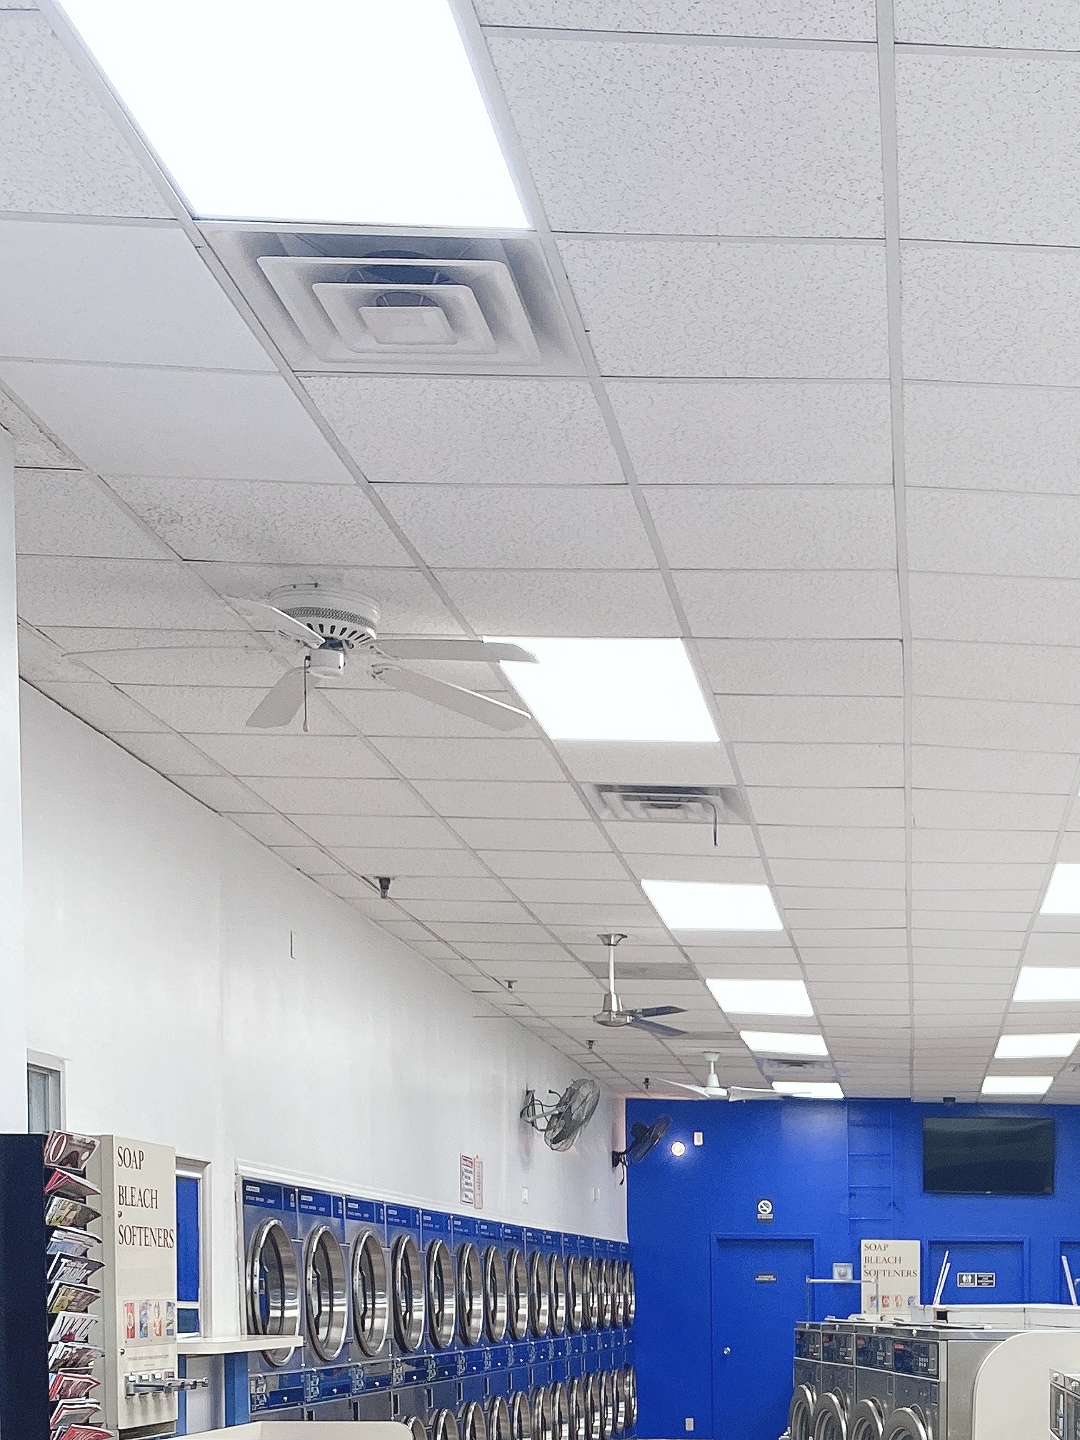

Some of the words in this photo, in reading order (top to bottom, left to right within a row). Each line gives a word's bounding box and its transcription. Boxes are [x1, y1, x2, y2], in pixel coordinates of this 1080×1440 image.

[117, 1146, 144, 1170] SOAP
[118, 1185, 158, 1209] BLEACH
[118, 1225, 174, 1248] SOFTENERS
[864, 1243, 889, 1251] SOAP
[864, 1256, 902, 1264] BLEACH
